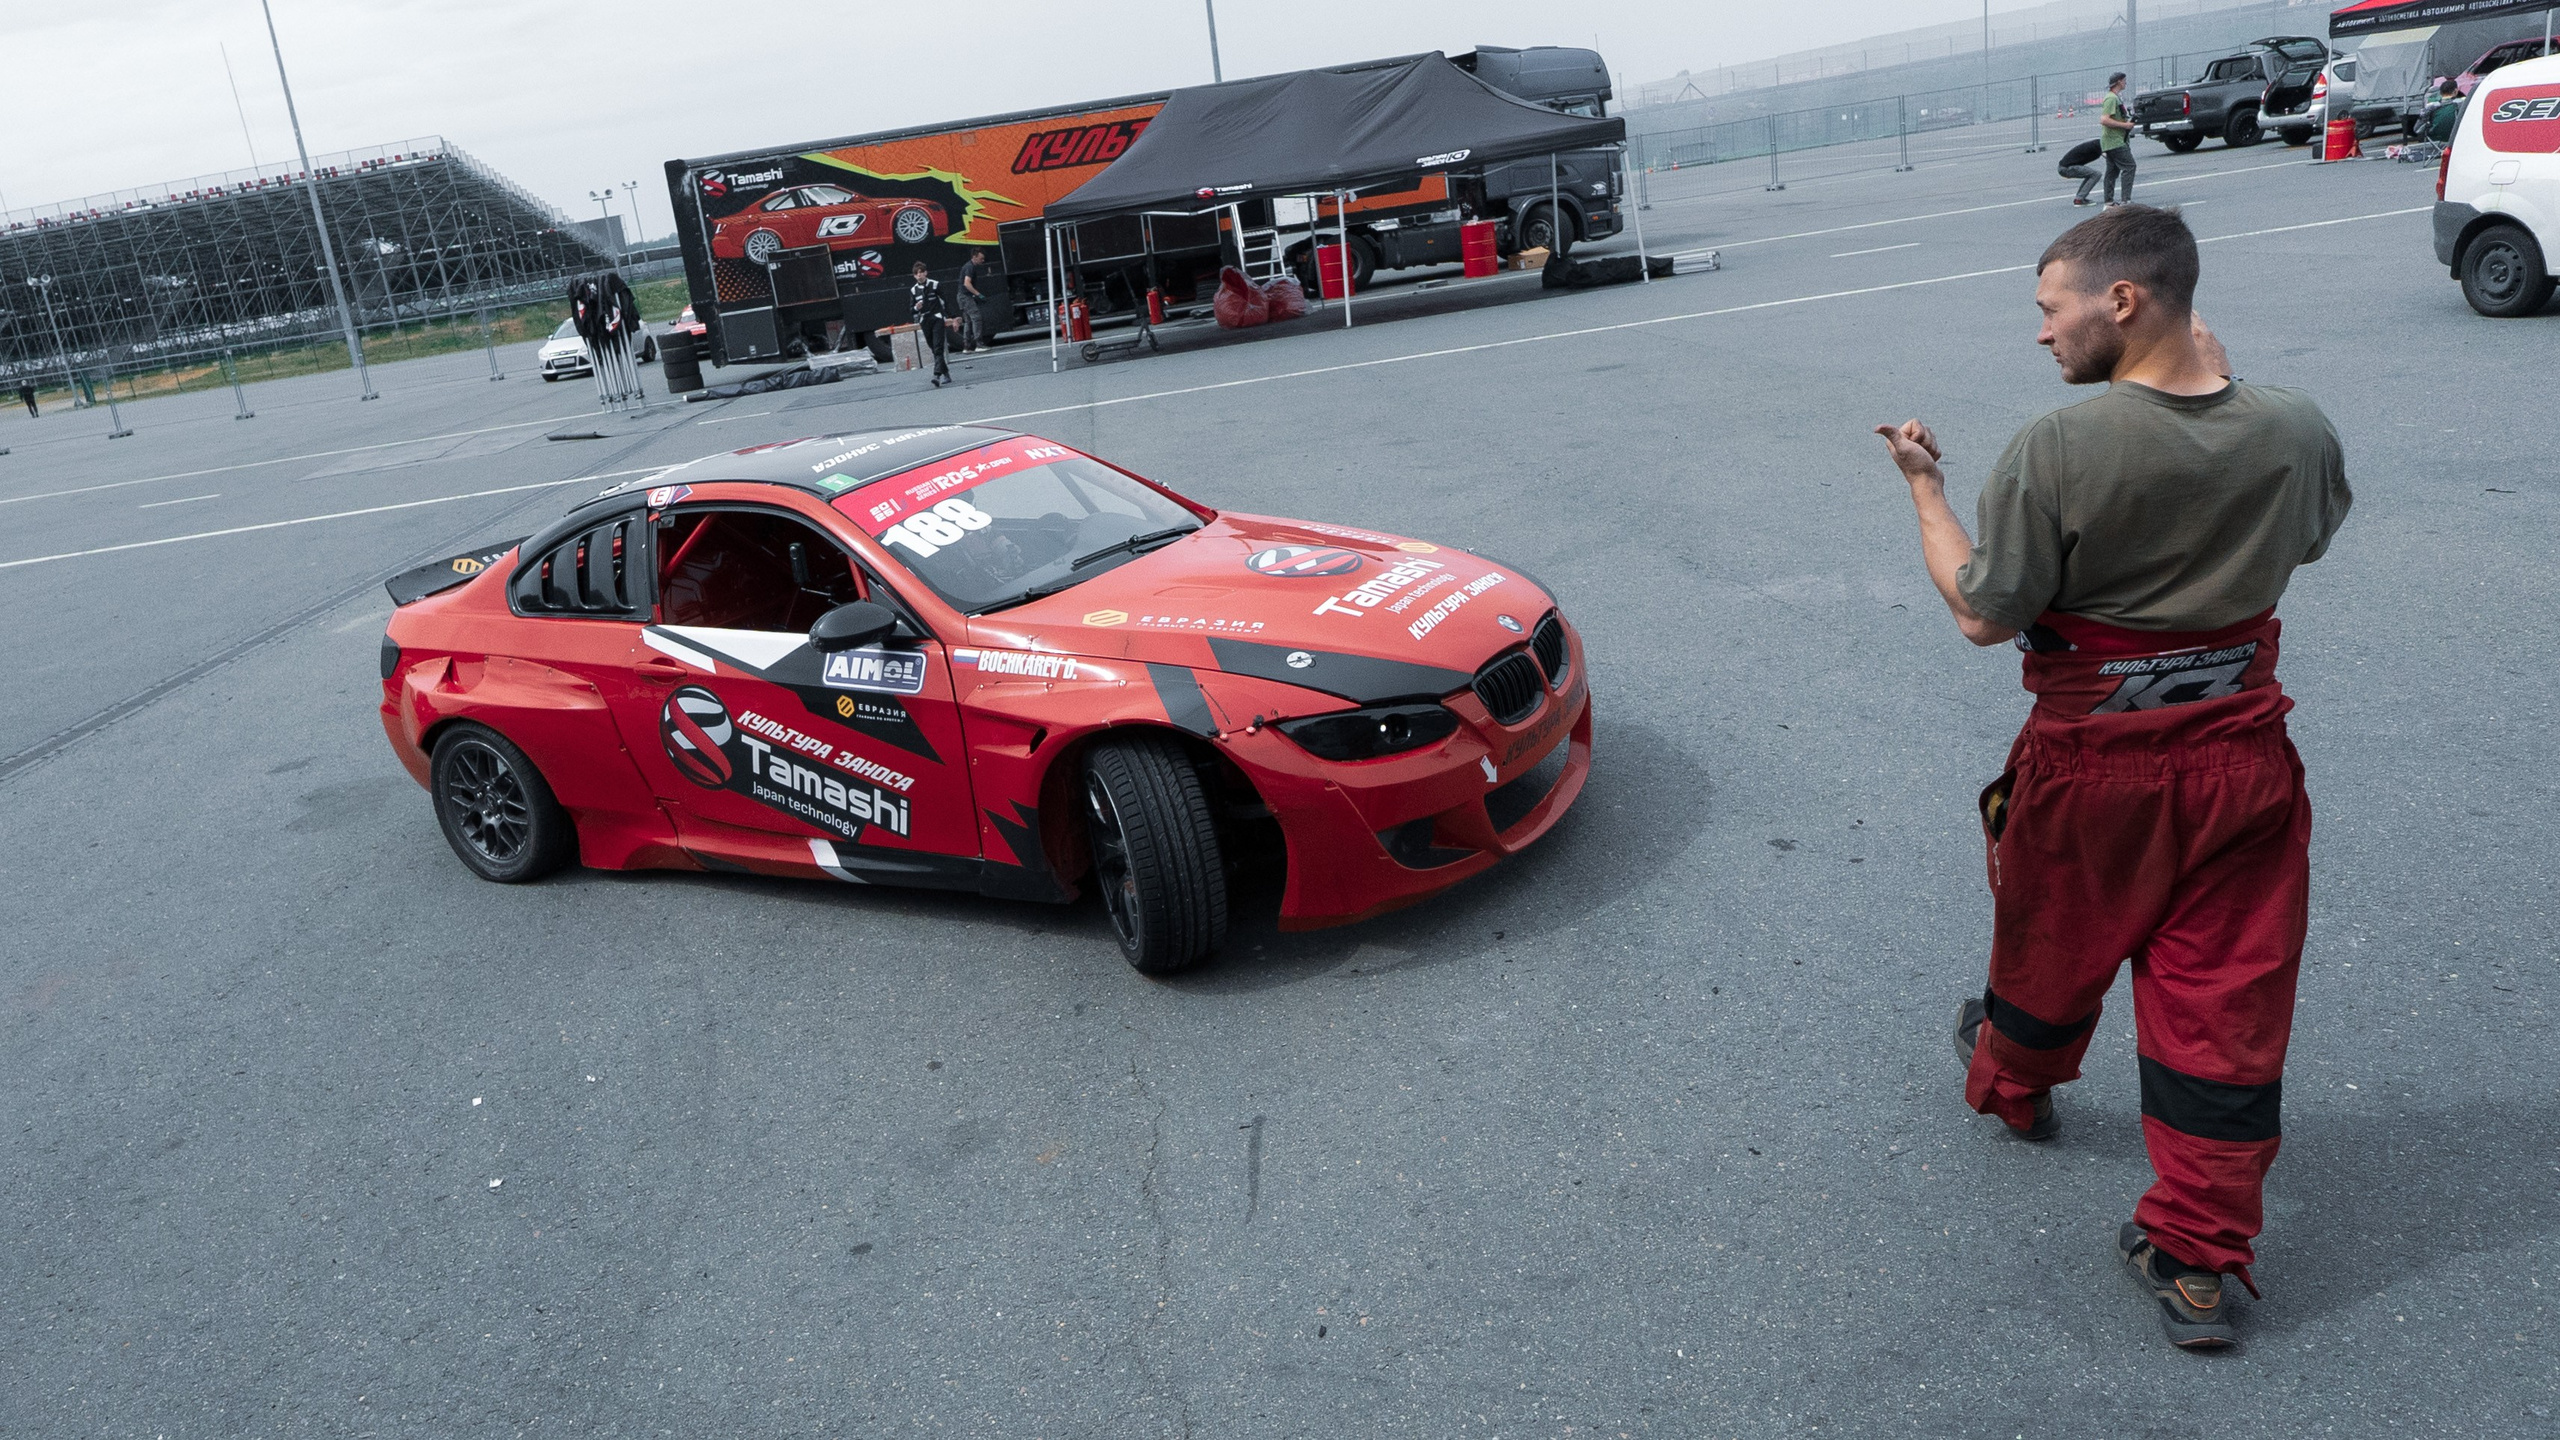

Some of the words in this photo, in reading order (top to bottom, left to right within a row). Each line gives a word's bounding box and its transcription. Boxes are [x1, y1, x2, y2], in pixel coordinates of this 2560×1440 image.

[2422, 4, 2465, 16] АВТОХИМИЯ
[727, 167, 783, 186] Tamashi
[811, 442, 880, 473] ЗАНОСА
[1024, 446, 1067, 460] NXT
[932, 465, 979, 491] RDS
[880, 498, 992, 558] 188
[1312, 556, 1446, 617] Tamashi
[1384, 595, 1416, 614] Japan
[1408, 573, 1457, 598] technology
[1408, 590, 1471, 641] КУЛЬТУРА
[1463, 571, 1507, 597] ЗАНОСА
[1140, 615, 1265, 629] ЕВРАЗИЯ
[828, 655, 918, 685] AIMOL
[978, 650, 1063, 678] BOCHKAREV
[1063, 657, 1078, 680] D.
[2098, 654, 2197, 675] КУЛЬТУРА
[2194, 641, 2258, 667] ЗАНОСА
[858, 703, 906, 718] ЕВРАЗИЯ
[737, 710, 833, 759] КУЛЬТУРА
[834, 751, 915, 792] ЗАНОСА
[741, 734, 908, 835] Tamashi
[753, 781, 786, 805] Japan
[787, 796, 857, 837] technology
